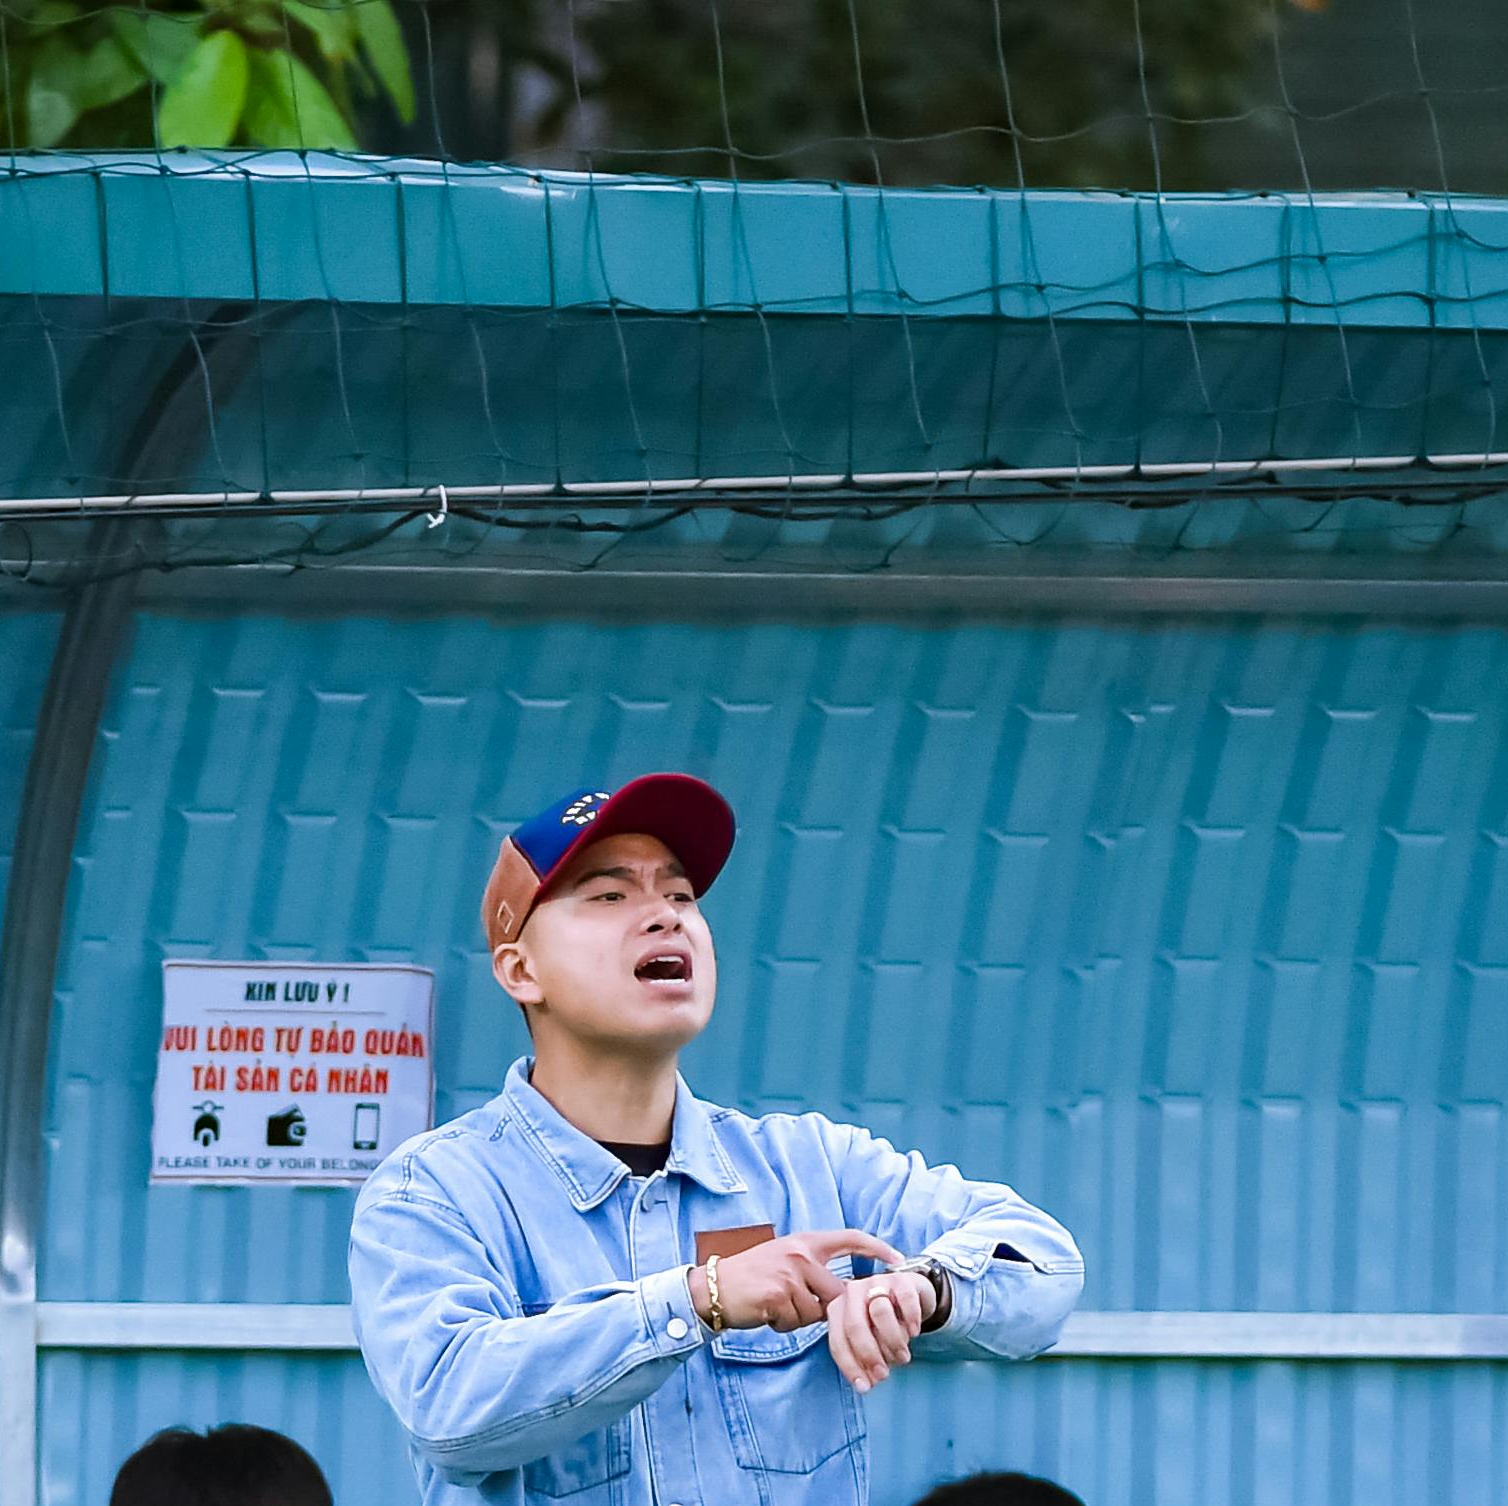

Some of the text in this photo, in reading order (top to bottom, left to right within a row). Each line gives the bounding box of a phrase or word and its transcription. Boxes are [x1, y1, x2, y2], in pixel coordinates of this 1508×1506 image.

[244, 981, 278, 1002] XIN
[284, 980, 320, 1003] LƯU
[206, 1020, 265, 1052] LÒNG
[275, 1025, 305, 1058] TỰ
[310, 1020, 356, 1054] BẢO
[192, 1060, 227, 1092] TÀI
[235, 1058, 280, 1093] SẢN
[289, 1062, 320, 1093] CÁ
[158, 1156, 209, 1169] PLEASE
[216, 1156, 250, 1170] TAKE
[256, 1157, 273, 1170] OF
[279, 1157, 316, 1170] YOUR
